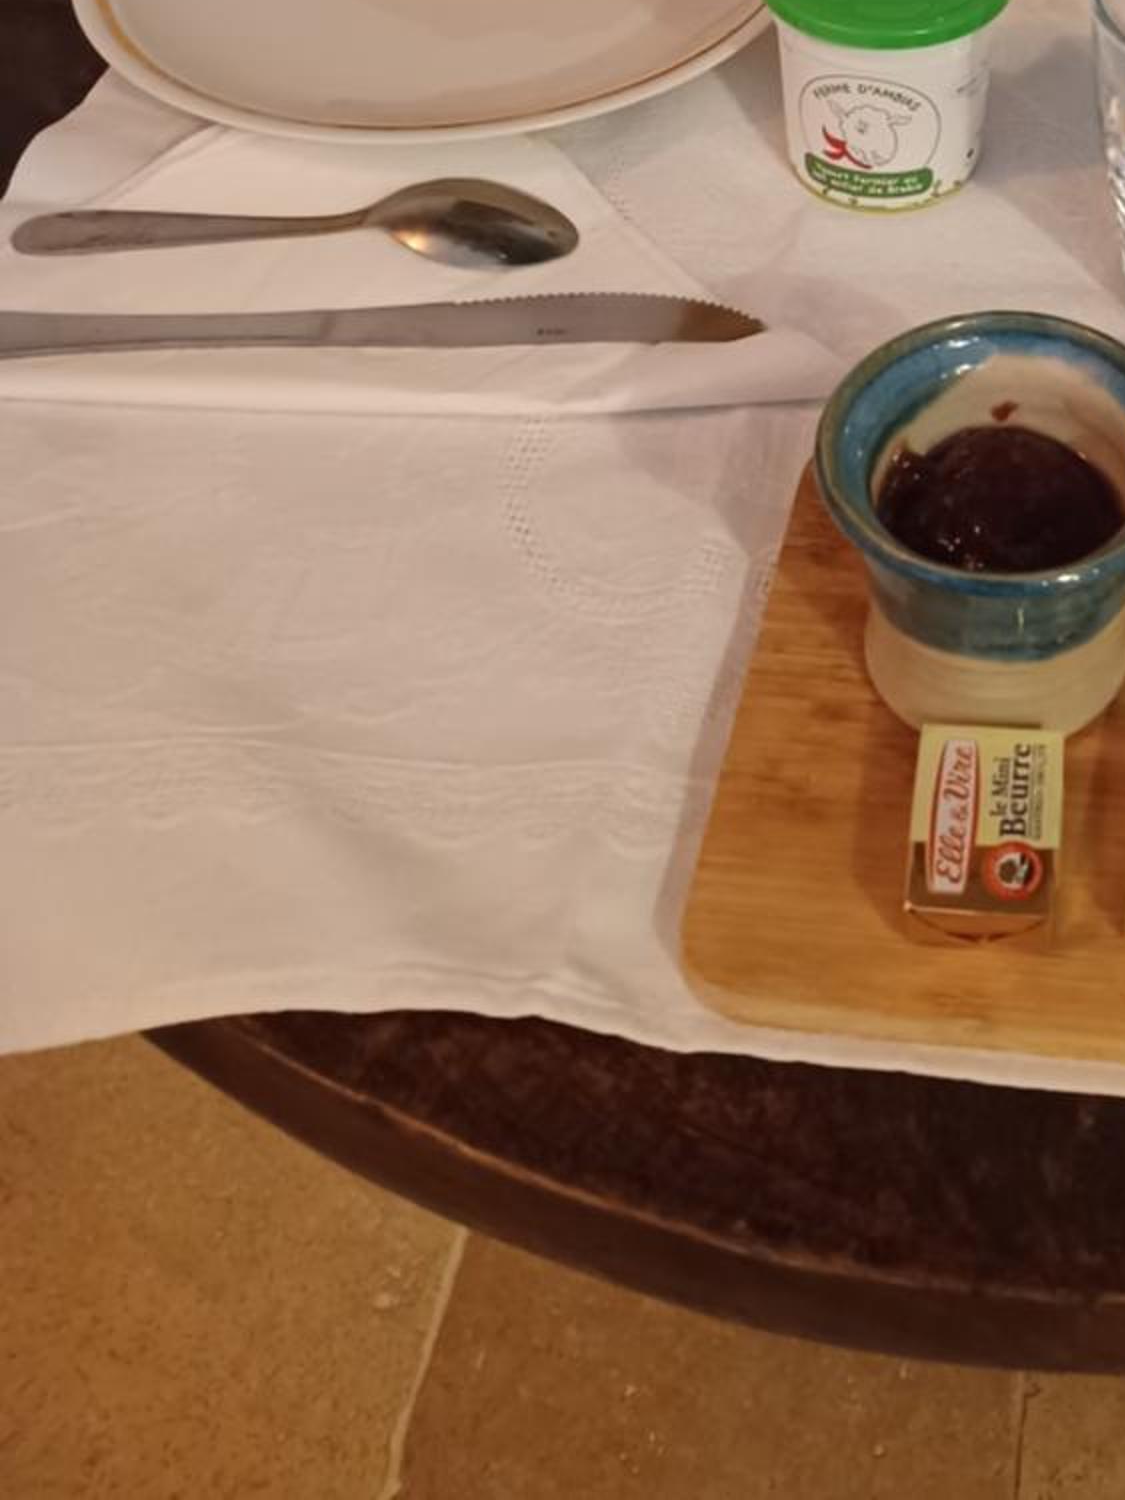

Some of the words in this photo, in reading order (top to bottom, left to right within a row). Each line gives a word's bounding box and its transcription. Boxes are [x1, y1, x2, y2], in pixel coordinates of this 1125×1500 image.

[943, 745, 973, 800] Vire
[991, 756, 1011, 798] Mini
[1000, 743, 1031, 836] Beurre
[989, 802, 1008, 818] le
[936, 823, 966, 885] Elle
